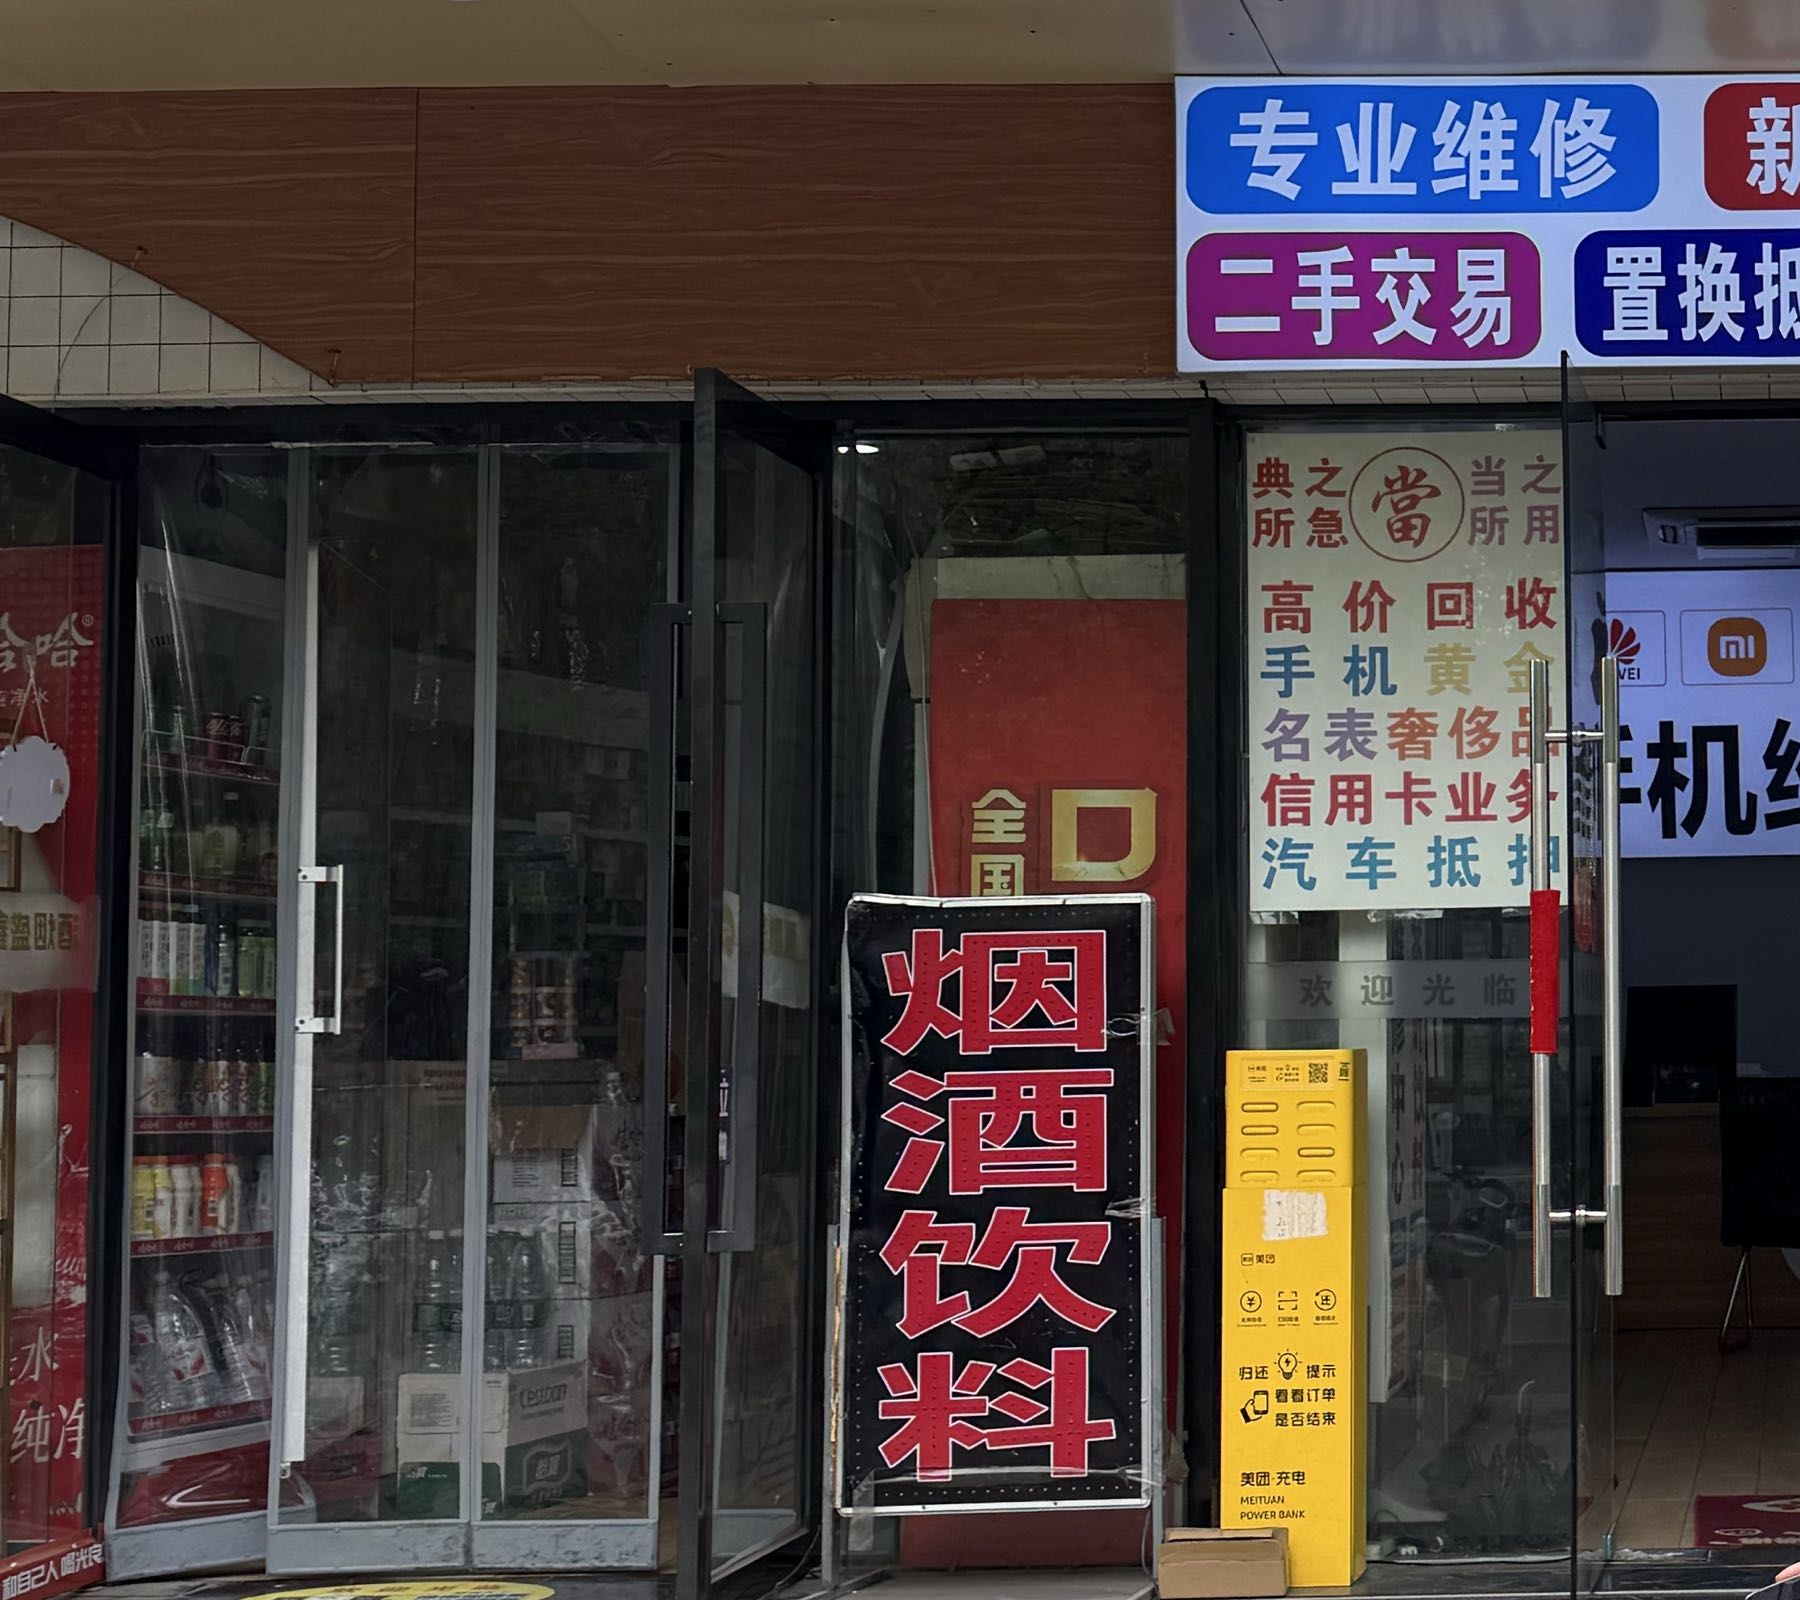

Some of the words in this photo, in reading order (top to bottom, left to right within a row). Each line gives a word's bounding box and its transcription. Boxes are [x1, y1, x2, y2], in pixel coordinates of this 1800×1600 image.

[1229, 95, 1618, 200] 专业维修
[1214, 247, 1514, 348] 二手交易
[1252, 457, 1347, 499] 典之
[1470, 455, 1562, 497] 当之
[1251, 507, 1349, 549] 所急
[1468, 504, 1560, 547] 所用
[1261, 577, 1558, 634] 高价回收
[1260, 641, 1556, 699] 手机黄金
[1262, 705, 1560, 763] 名表奢侈品
[1261, 772, 1557, 827] 信用卡业务
[971, 789, 1026, 896] 全国
[1262, 836, 1560, 891] 汽车抵押
[1300, 972, 1517, 1008] 欢迎光临
[879, 928, 1116, 1482] 烟酒饮料
[1239, 1366, 1269, 1380] 归还
[1307, 1365, 1336, 1379] 提示
[1275, 1388, 1336, 1403] 看看订单
[1275, 1412, 1336, 1427] 是否结束
[1240, 1496, 1284, 1505] MEITUAN
[1240, 1511, 1276, 1520] POWER
[1279, 1510, 1305, 1519] BANK
